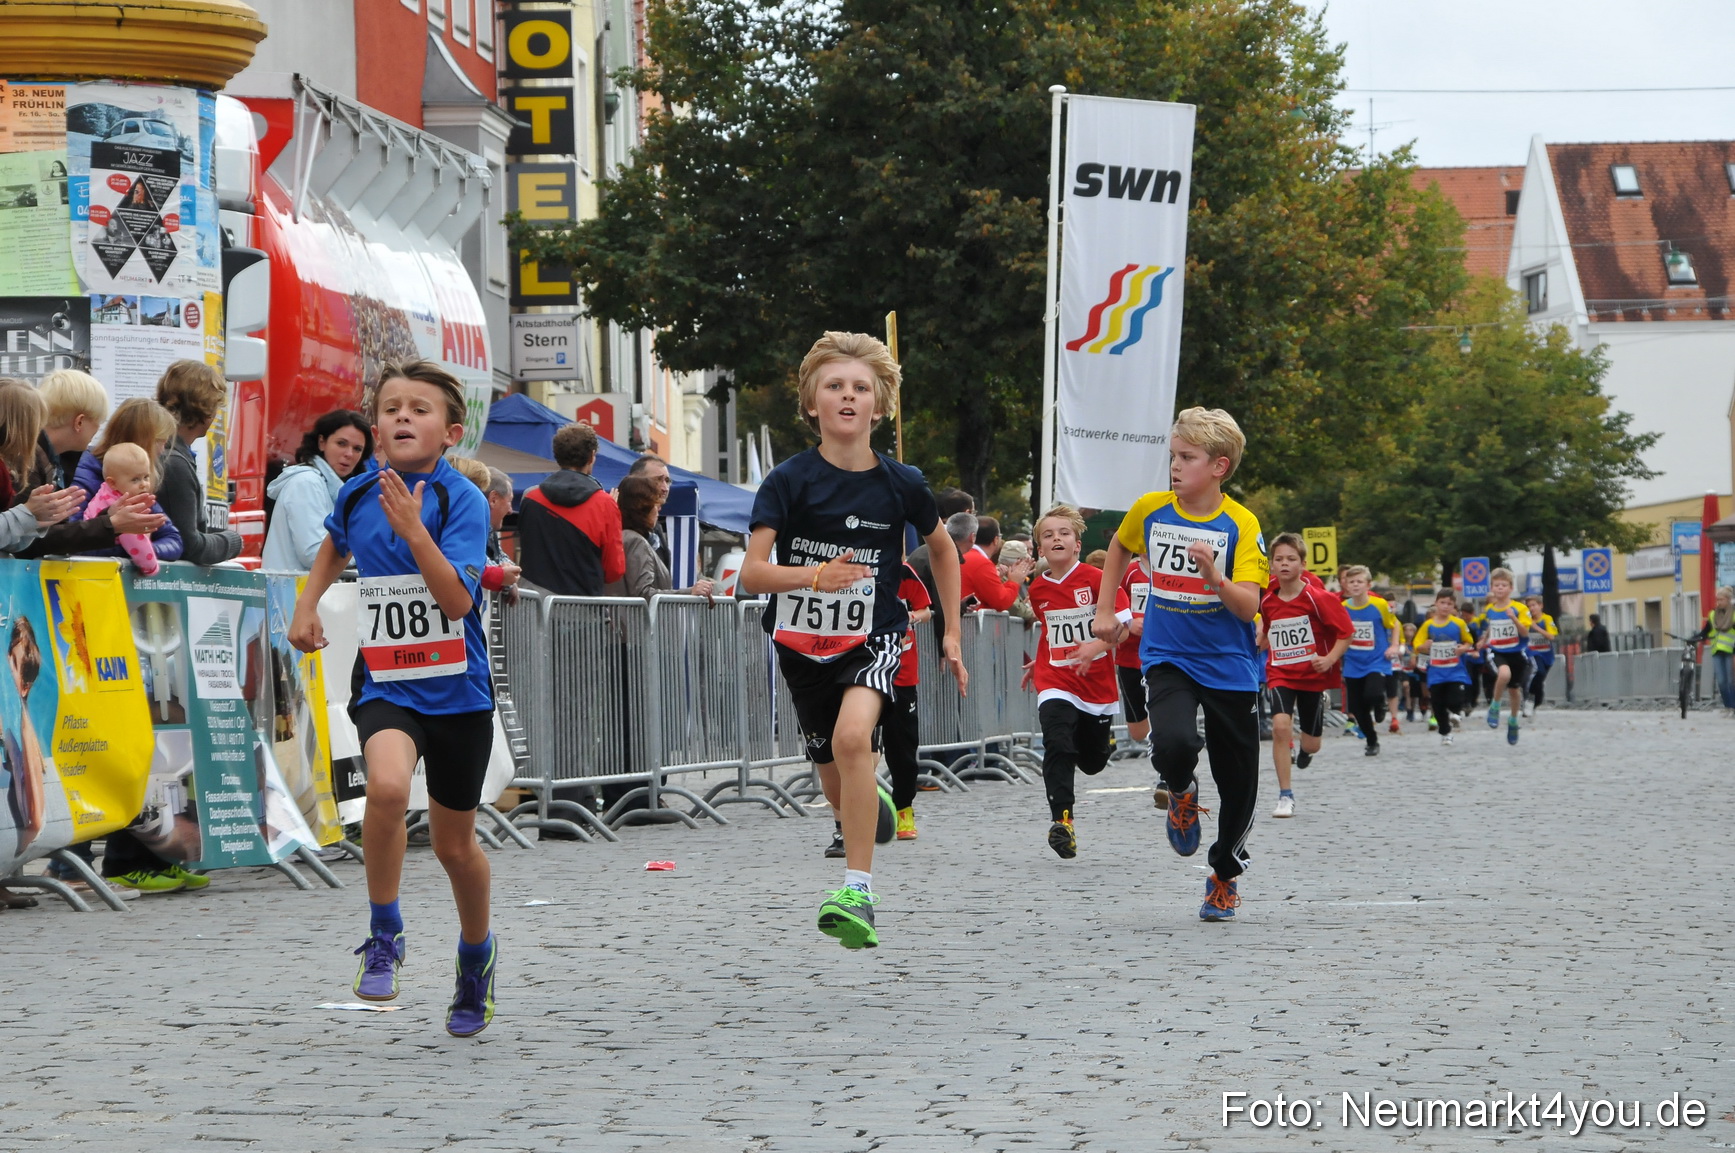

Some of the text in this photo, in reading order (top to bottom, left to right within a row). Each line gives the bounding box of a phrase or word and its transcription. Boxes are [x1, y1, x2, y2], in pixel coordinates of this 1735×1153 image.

[12, 89, 64, 97] 38. NEUM
[12, 99, 64, 109] FRÜHLIN
[122, 151, 154, 165] JAZZ
[1072, 162, 1182, 204] swn
[515, 320, 576, 328] Altstadthotel
[0, 330, 74, 352] ENN
[160, 336, 170, 345] für
[523, 333, 568, 348] Stern
[1063, 425, 1120, 441] sadtwerke
[1152, 530, 1176, 540] PARTL
[1307, 529, 1332, 539] Block
[789, 553, 803, 565] im
[1312, 542, 1329, 565] D
[1160, 575, 1185, 589] Felix
[1586, 579, 1611, 590] TAXI
[360, 586, 387, 598] PARTL
[1465, 585, 1488, 595] TAXI
[787, 594, 865, 631] 7519
[1063, 611, 1092, 621] Neumarkt
[367, 600, 450, 641] 7081
[1271, 627, 1310, 648] 7062
[1492, 626, 1516, 638] 7142
[393, 650, 427, 665] Finn
[1275, 648, 1306, 659] Maurice
[62, 714, 89, 730] Pflaster
[57, 738, 109, 756] Außenplatten
